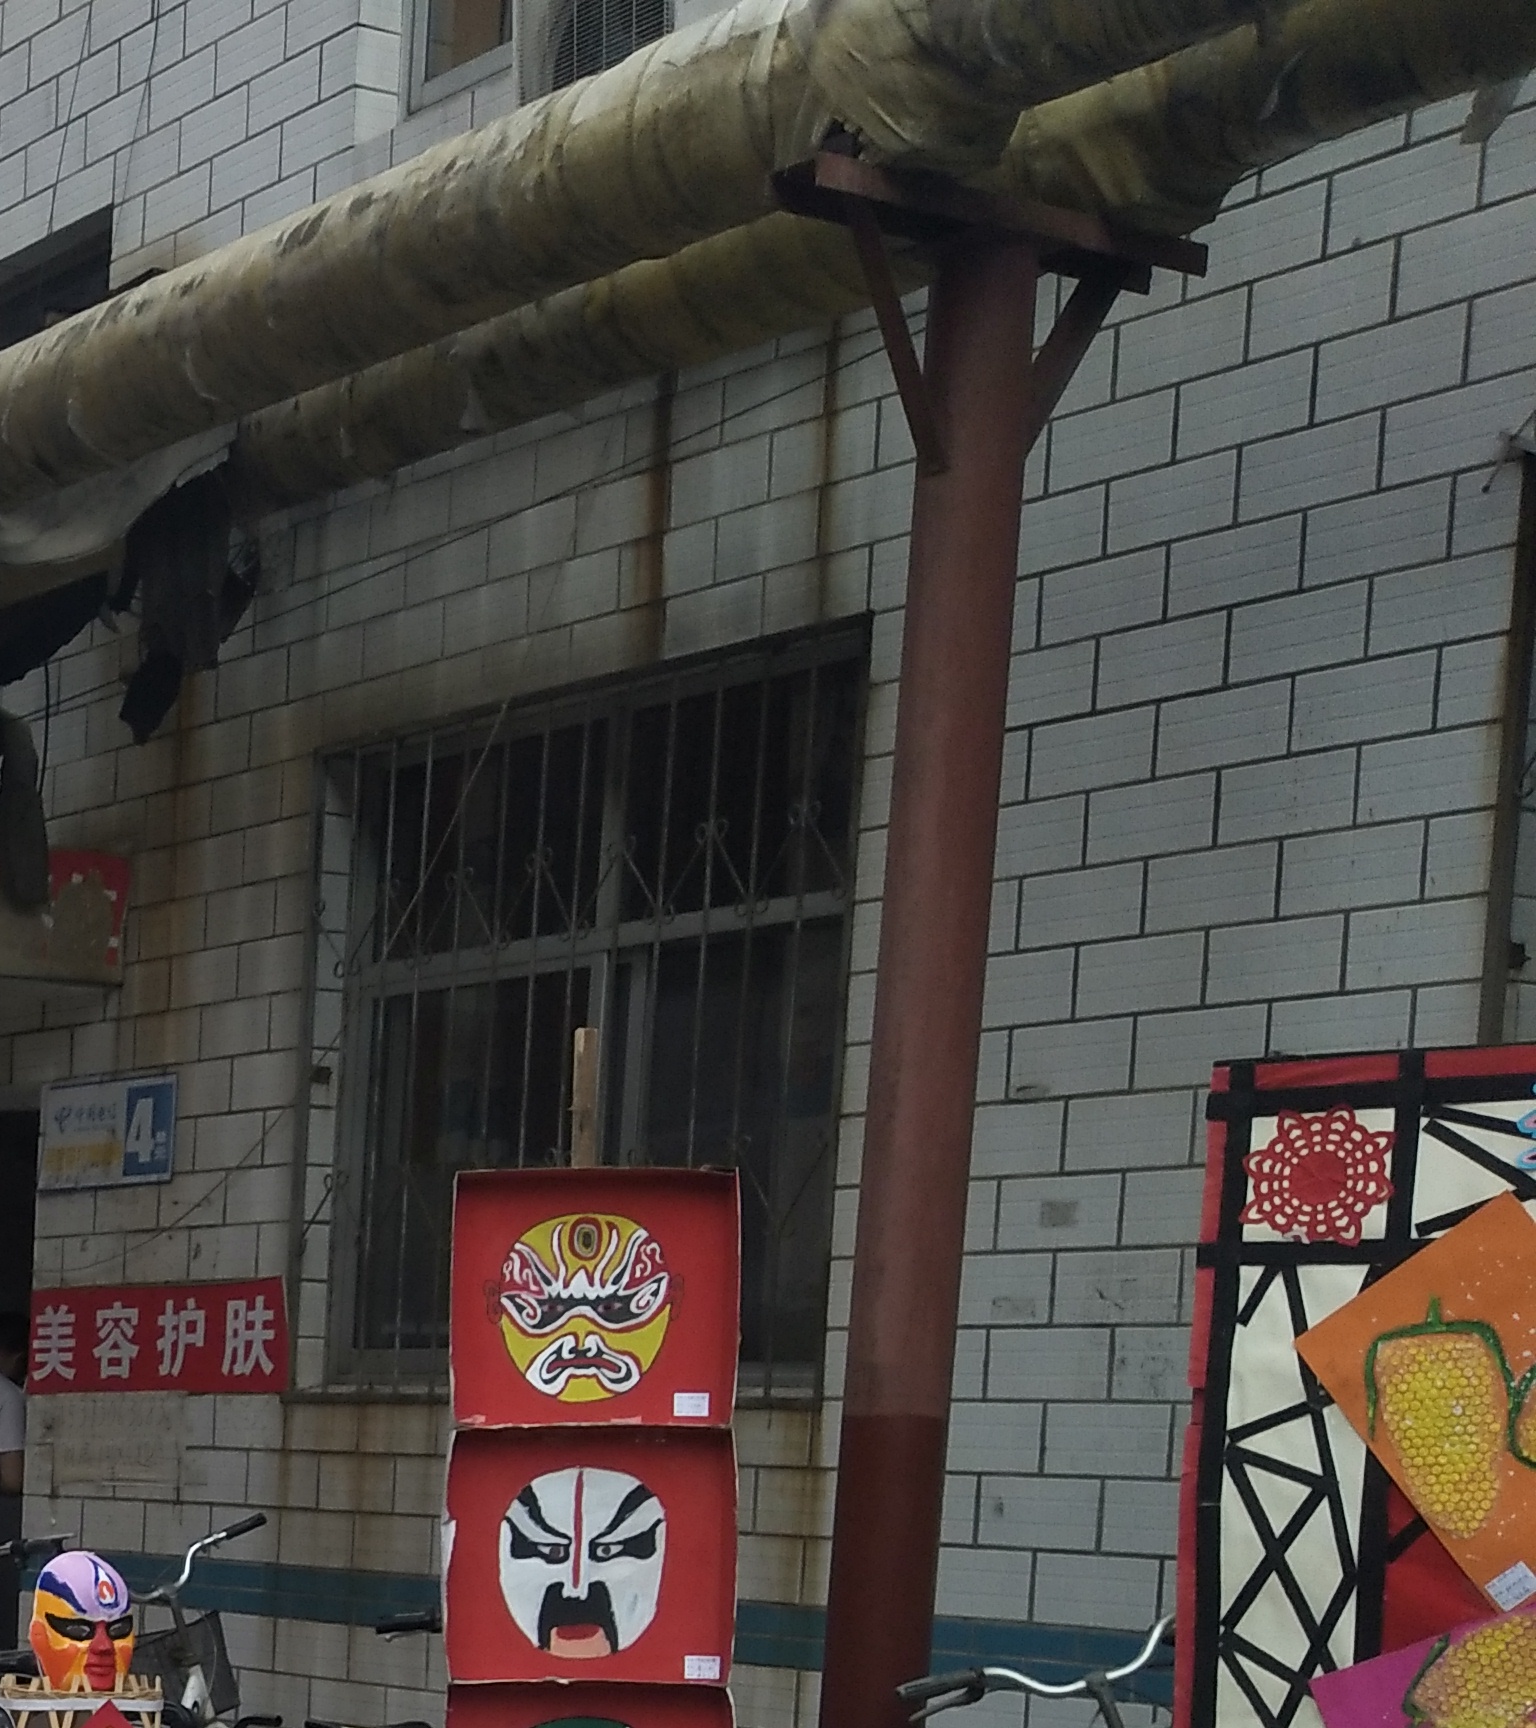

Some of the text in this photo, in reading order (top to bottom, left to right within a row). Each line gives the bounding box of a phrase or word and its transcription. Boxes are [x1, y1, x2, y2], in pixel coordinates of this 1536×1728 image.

[125, 1097, 155, 1163] 4
[32, 1295, 276, 1381] 美容护肤
